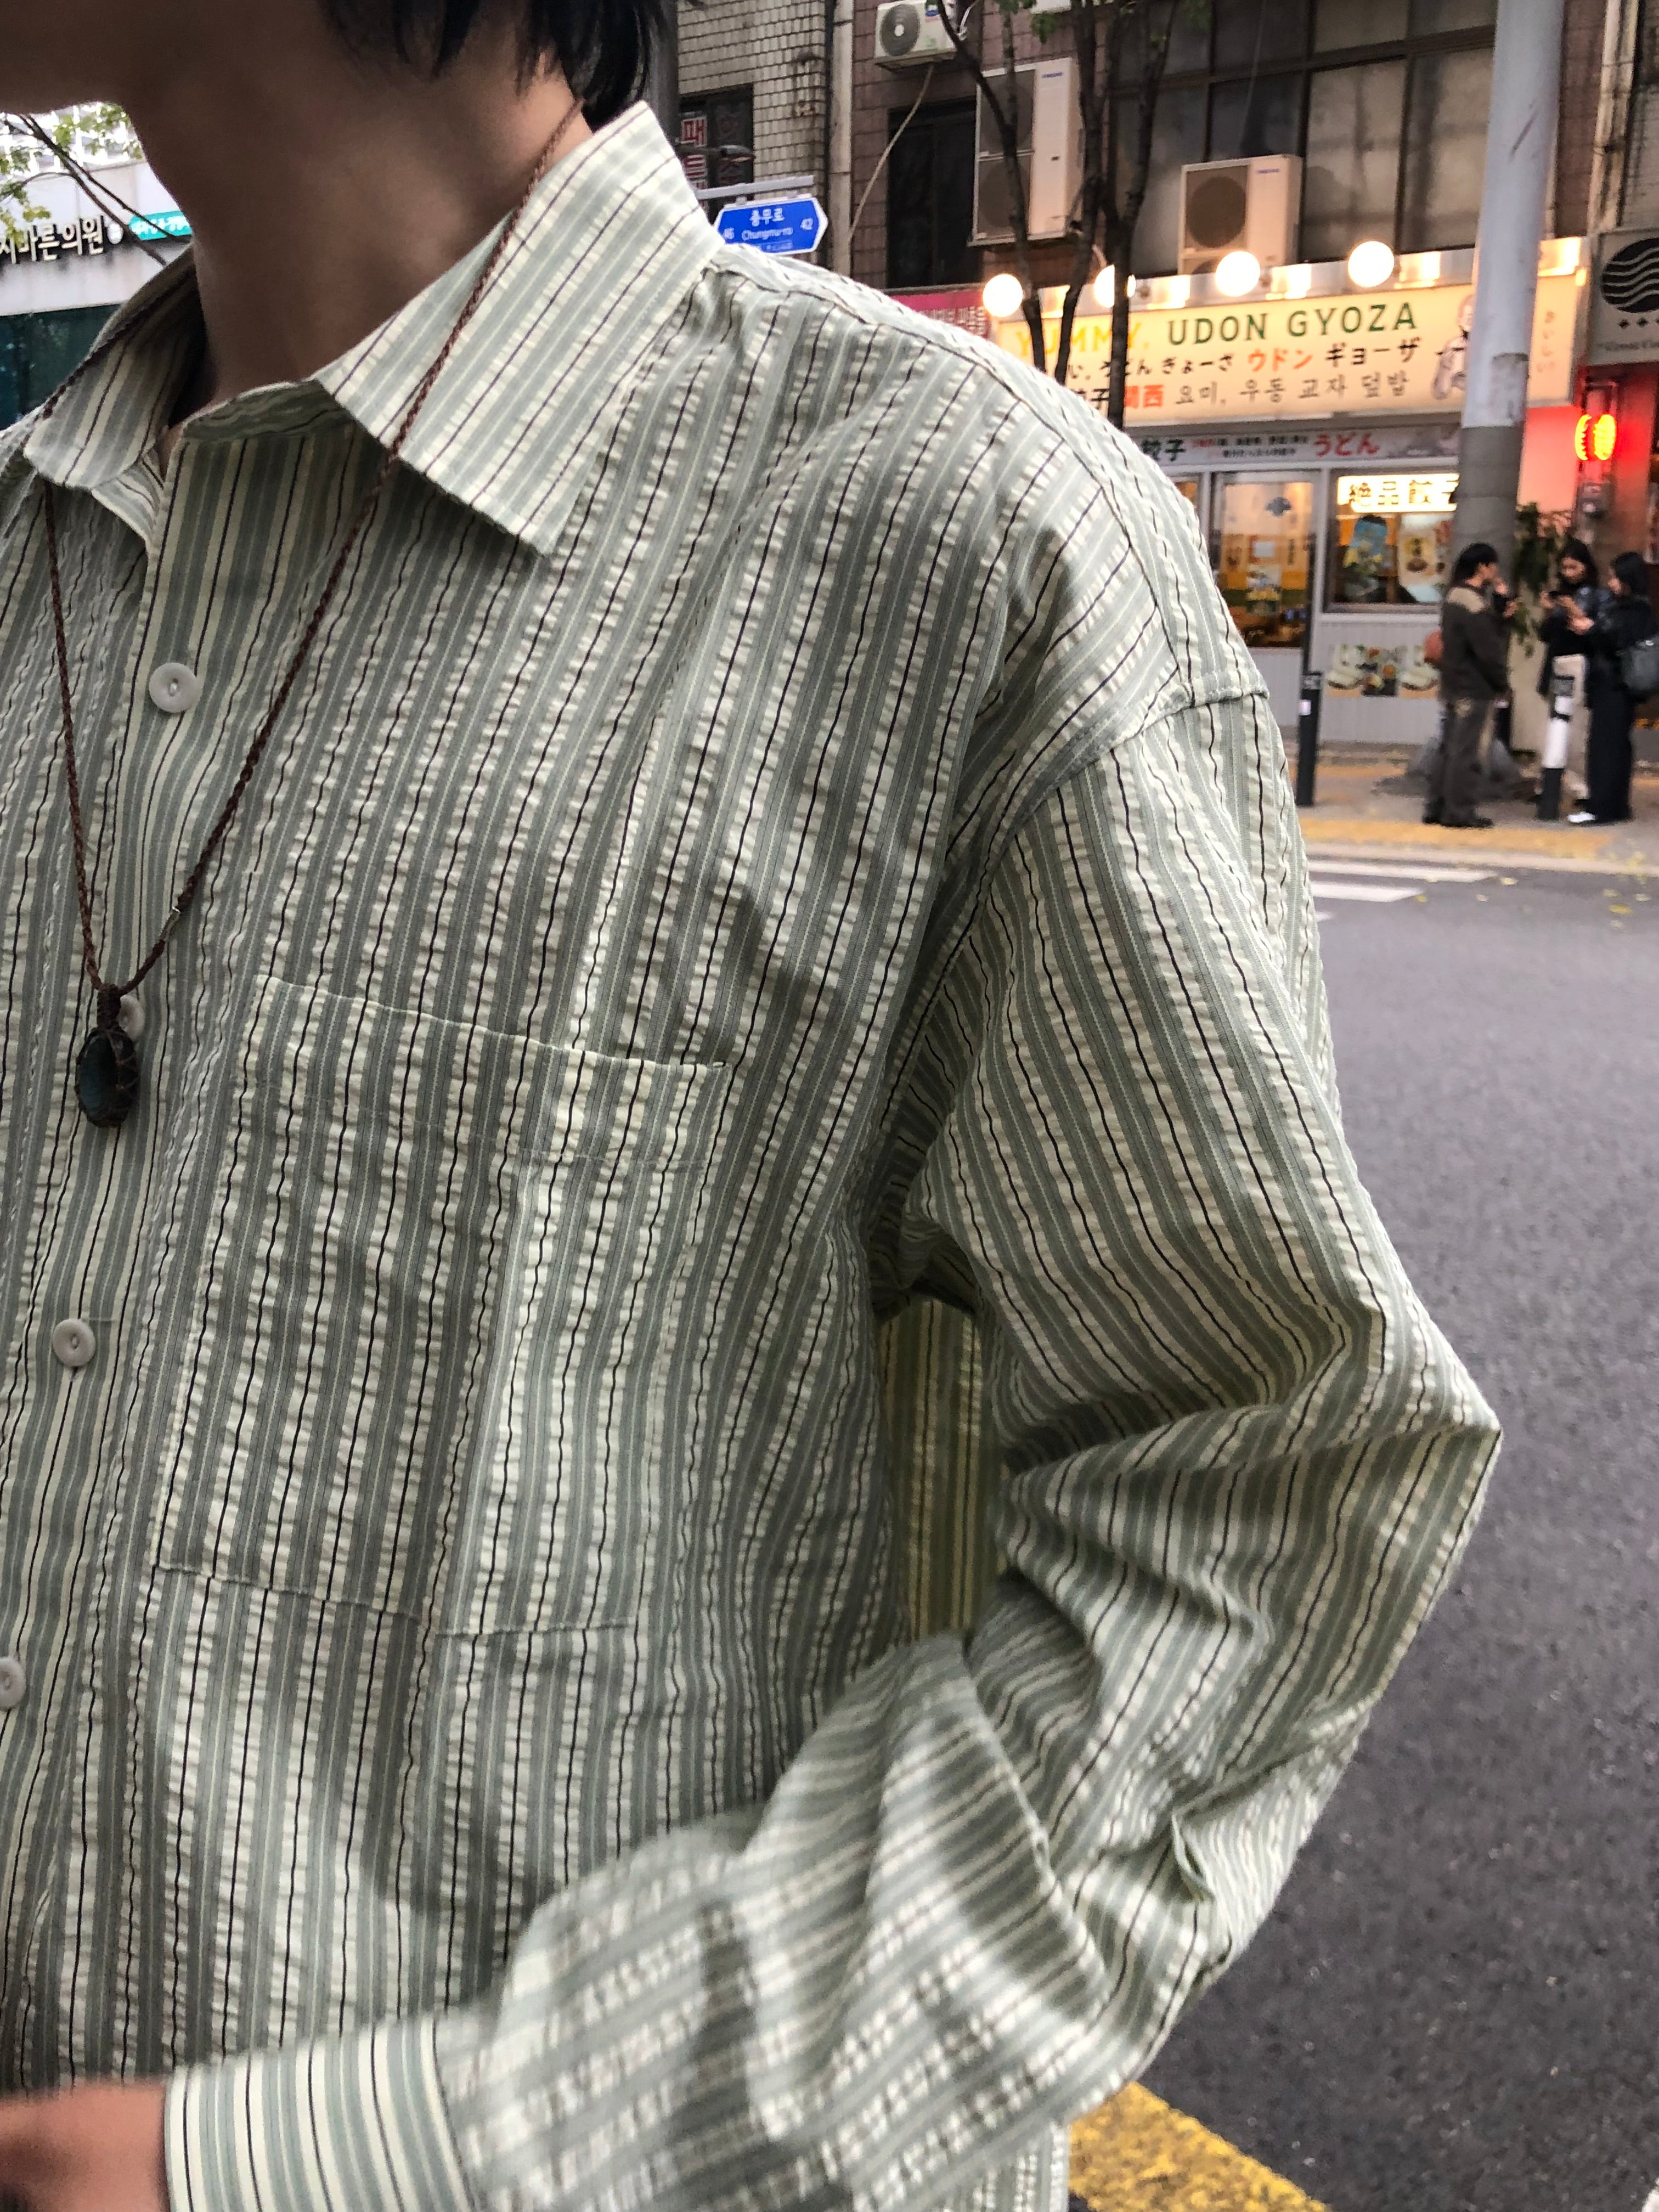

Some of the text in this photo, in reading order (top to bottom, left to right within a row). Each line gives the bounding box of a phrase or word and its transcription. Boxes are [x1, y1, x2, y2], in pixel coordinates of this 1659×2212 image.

[749, 207, 785, 227] 충무로
[1169, 313, 1269, 346] UDON
[1288, 302, 1417, 337] GYOZA
[1248, 348, 1313, 372] ウドン
[1325, 337, 1421, 368] ギョーザ
[1239, 377, 1286, 403] 우동
[1298, 374, 1347, 399] 교자
[1361, 370, 1409, 398] 덮밥
[1313, 431, 1380, 458] うどん
